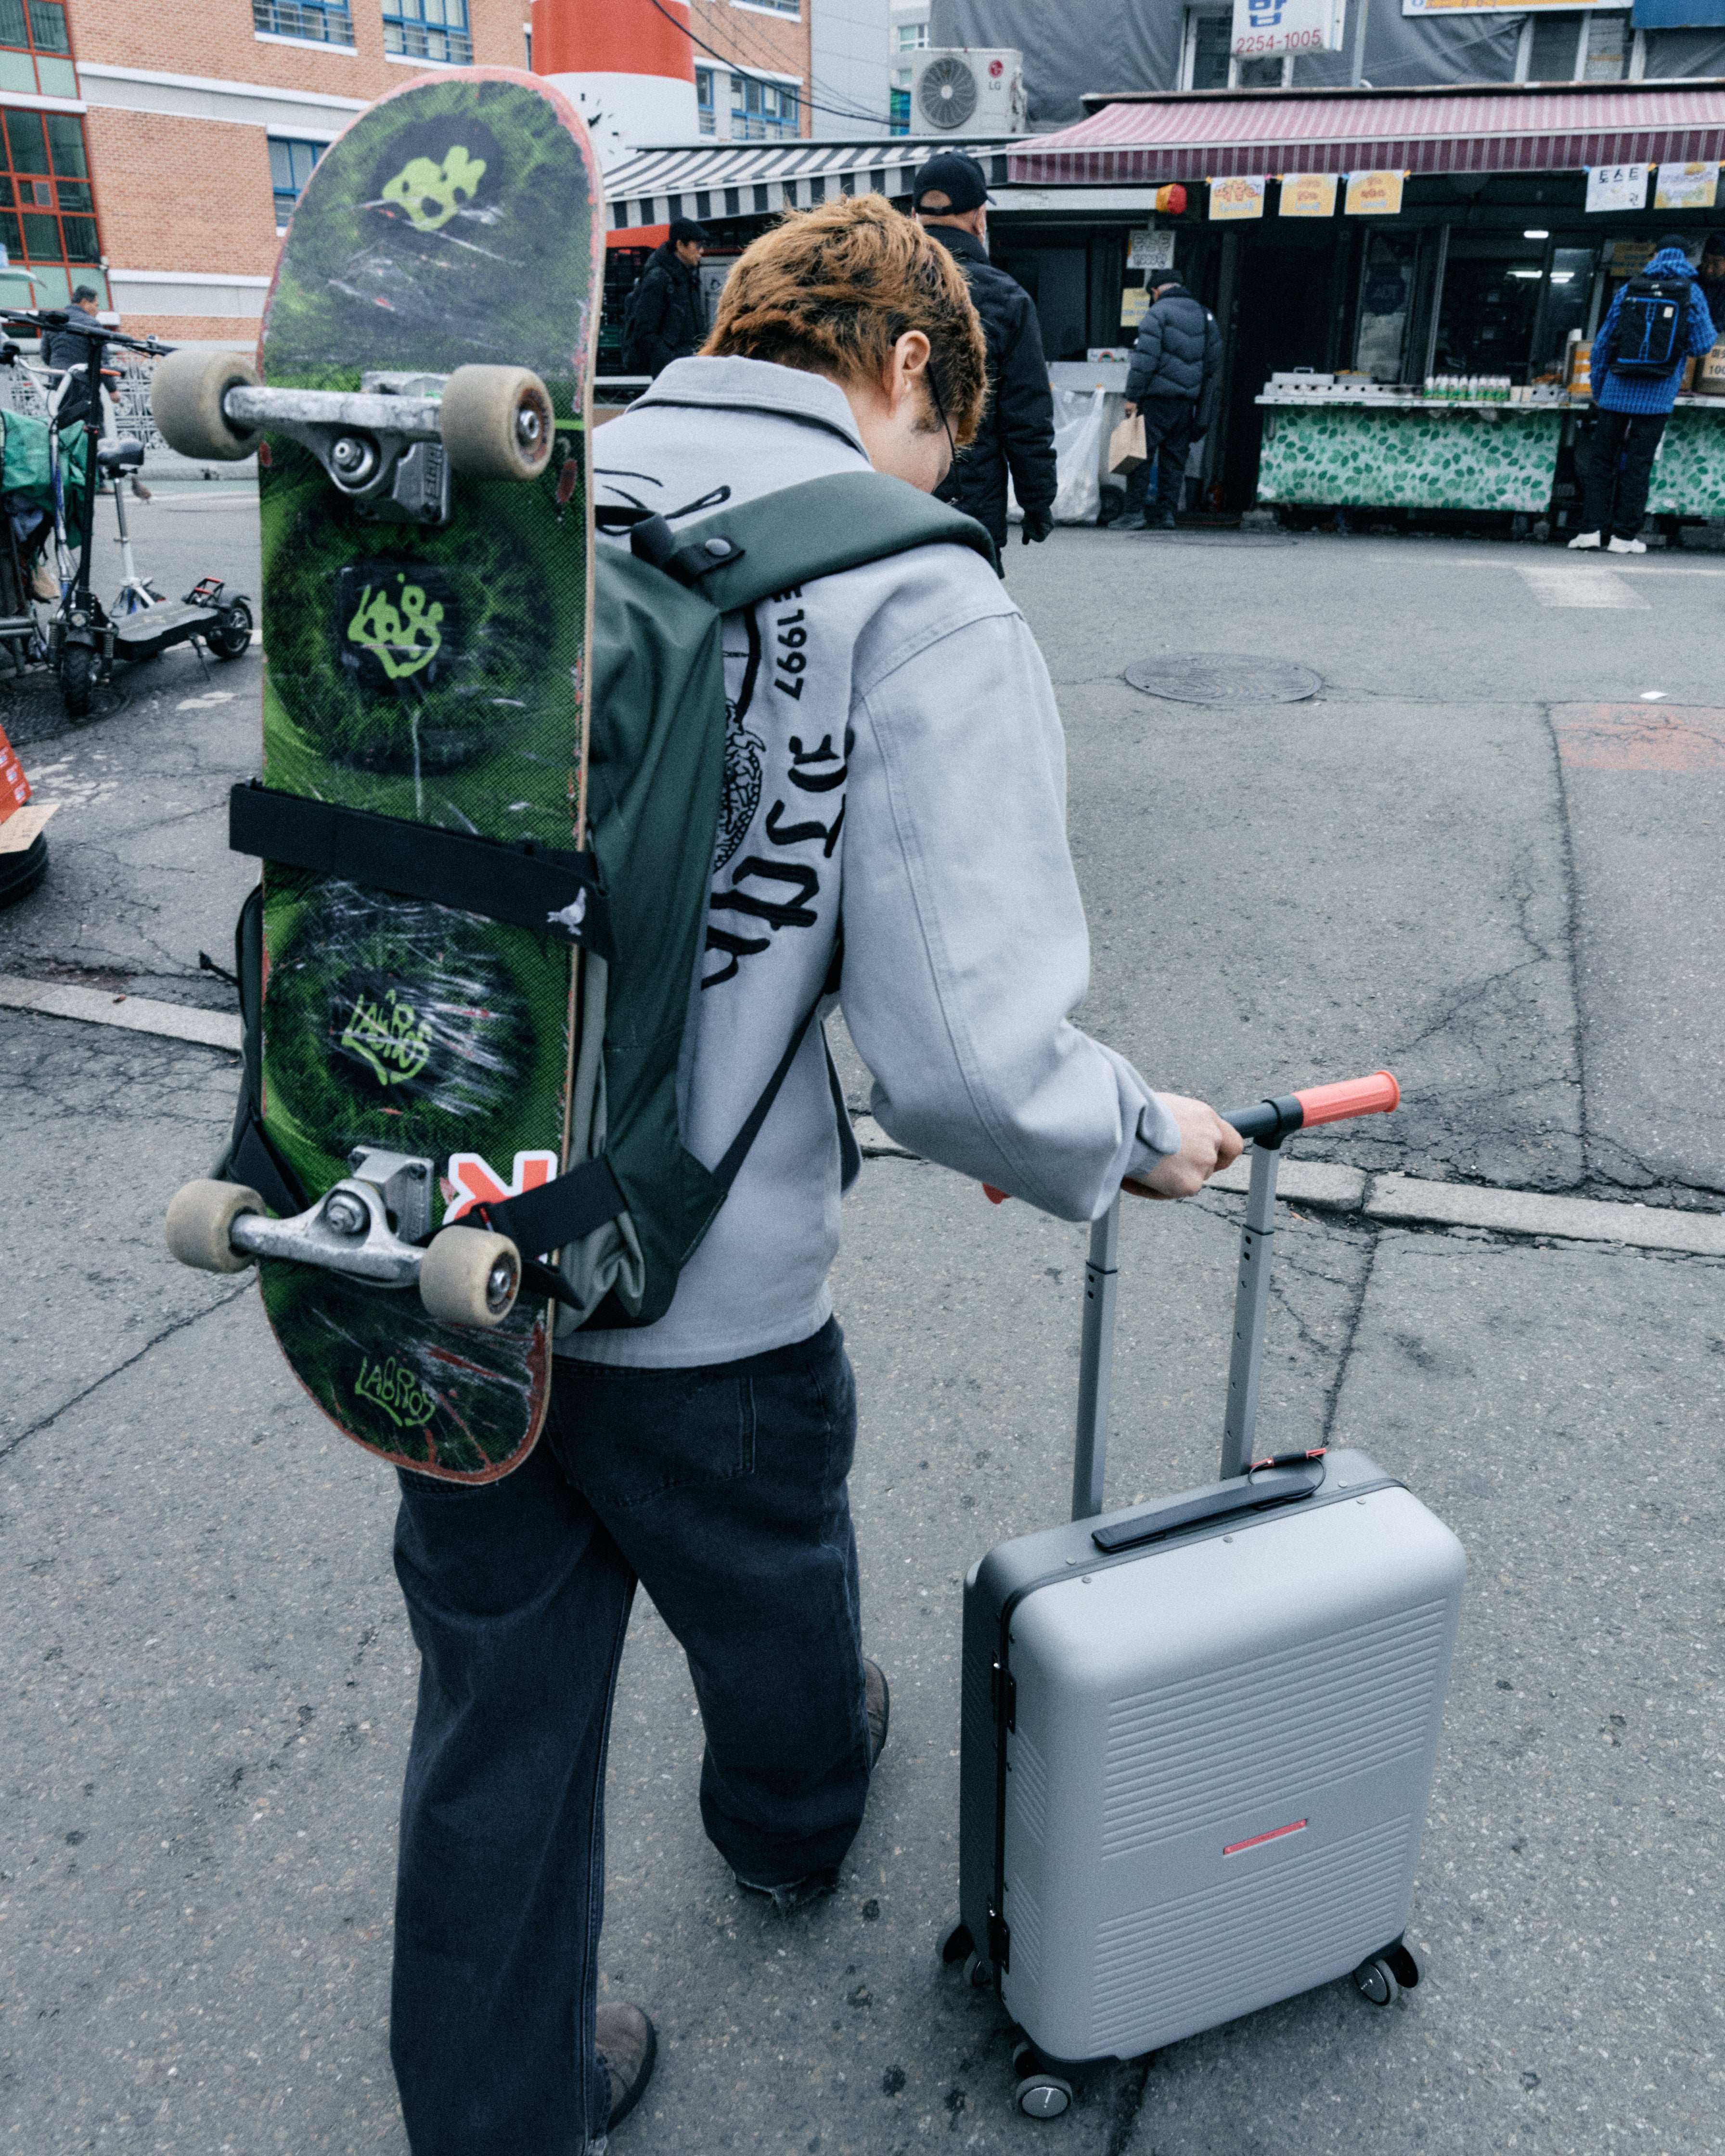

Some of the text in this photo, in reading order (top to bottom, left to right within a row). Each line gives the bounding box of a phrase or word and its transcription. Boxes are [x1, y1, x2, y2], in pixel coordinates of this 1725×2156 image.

[1236, 29, 1321, 53] 2254-1005
[989, 81, 1001, 90] LG
[1599, 167, 1639, 184] 토스트
[773, 608, 807, 701] 1997
[354, 1356, 436, 1427] LABROS
